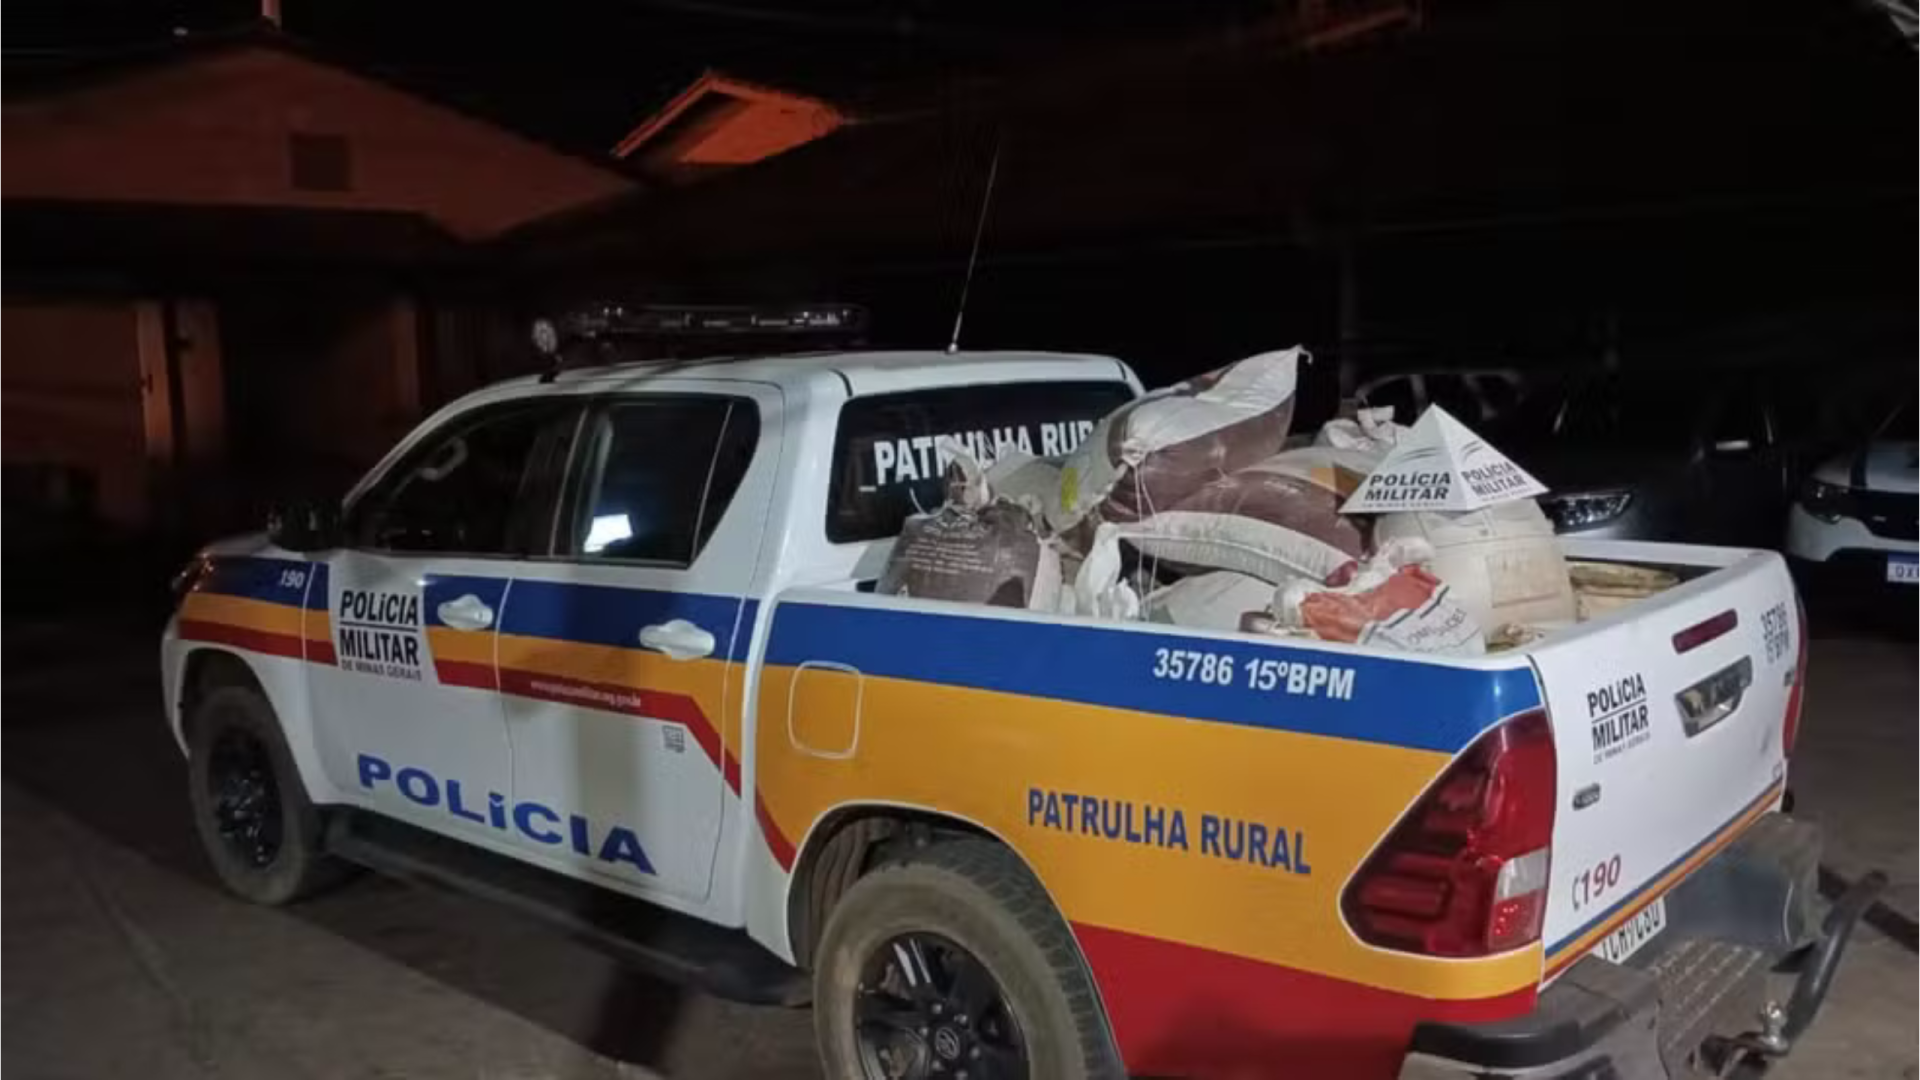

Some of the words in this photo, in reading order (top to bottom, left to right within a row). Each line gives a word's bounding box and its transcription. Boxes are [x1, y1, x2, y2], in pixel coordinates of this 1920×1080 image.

[1365, 487, 1449, 500] MILITAR
[1471, 474, 1527, 497] MILITAR
[280, 569, 305, 589] 190
[340, 629, 419, 666] MILITAR
[1153, 648, 1234, 685] 35786
[1592, 704, 1649, 751] MILITAR
[1028, 788, 1188, 851] PATRULHA
[1201, 814, 1311, 874] RURAL
